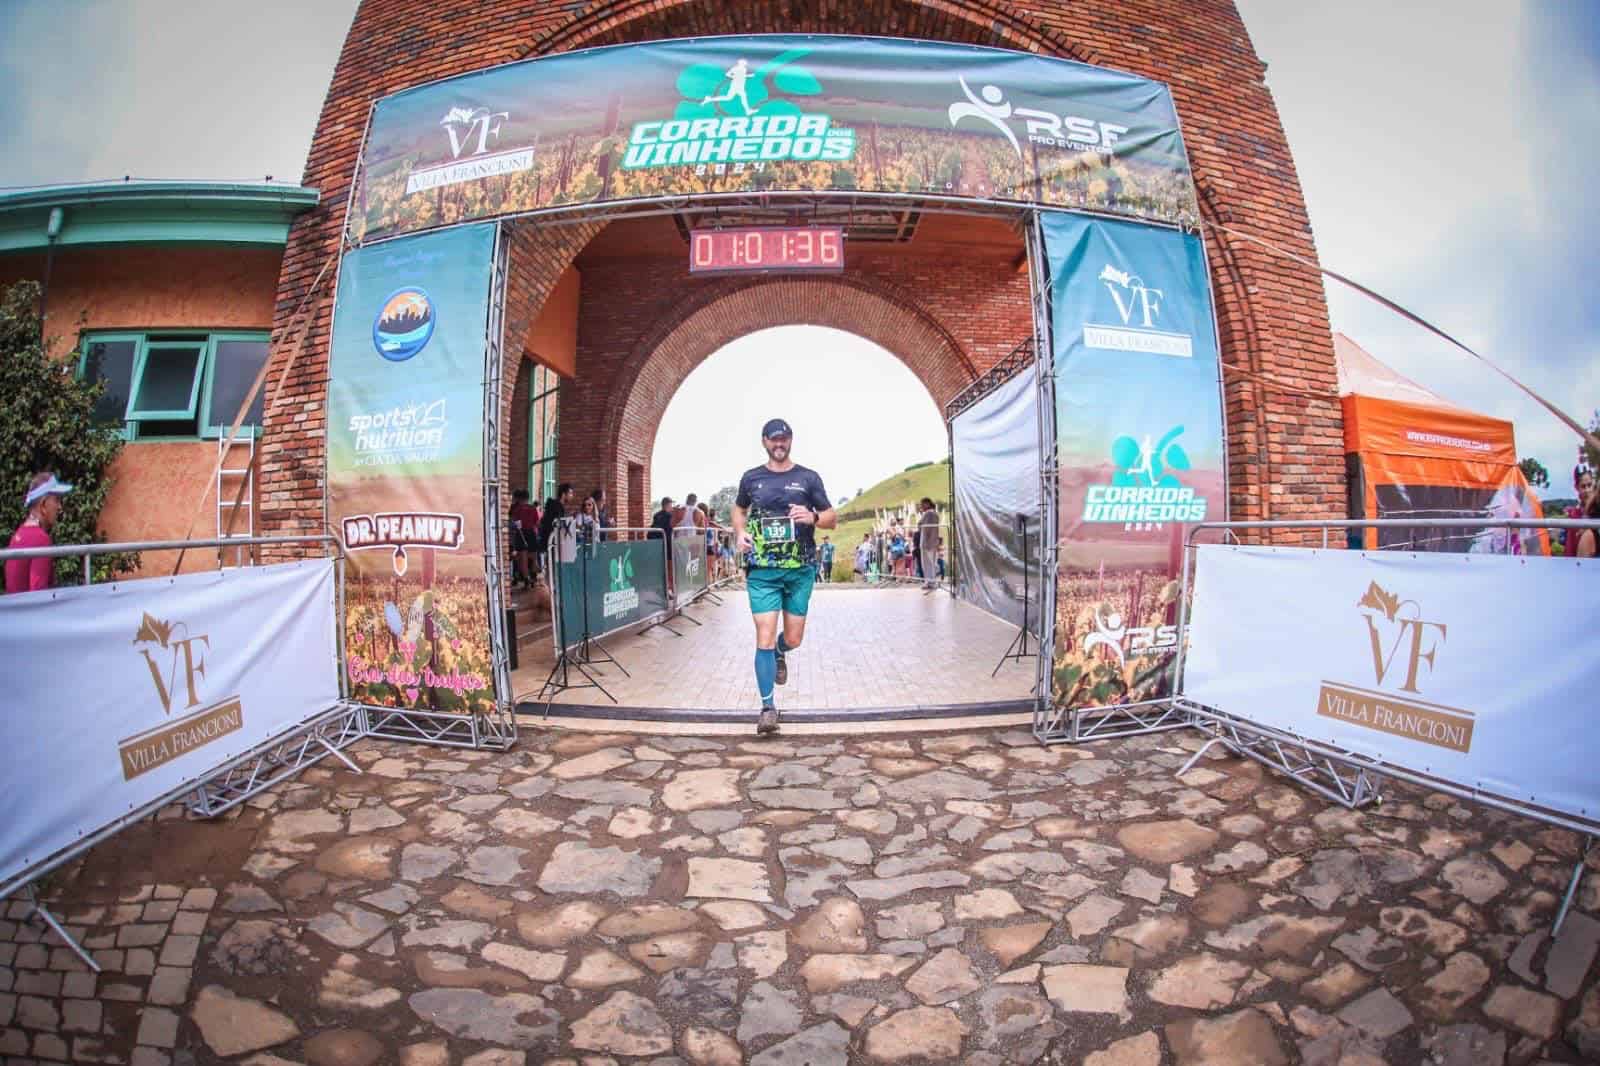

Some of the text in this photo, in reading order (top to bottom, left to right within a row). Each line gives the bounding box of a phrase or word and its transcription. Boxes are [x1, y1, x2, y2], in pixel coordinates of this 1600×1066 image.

[443, 112, 508, 160] VF
[631, 115, 829, 146] CORRIDA
[1014, 107, 1129, 149] RSF
[1029, 134, 1055, 145] PRO
[624, 138, 854, 167] VINHEDOS
[696, 162, 765, 176] 2024
[1103, 282, 1164, 328] VF
[1082, 503, 1206, 521] VINHEDOS
[1088, 486, 1194, 503] CORRIDA
[346, 515, 459, 545] DR. PEANUT
[1361, 613, 1447, 694] VF
[138, 634, 210, 716] VF
[1326, 693, 1466, 746] VILLA FRANCIONI
[127, 709, 239, 771] VILLA FRANCIONI
